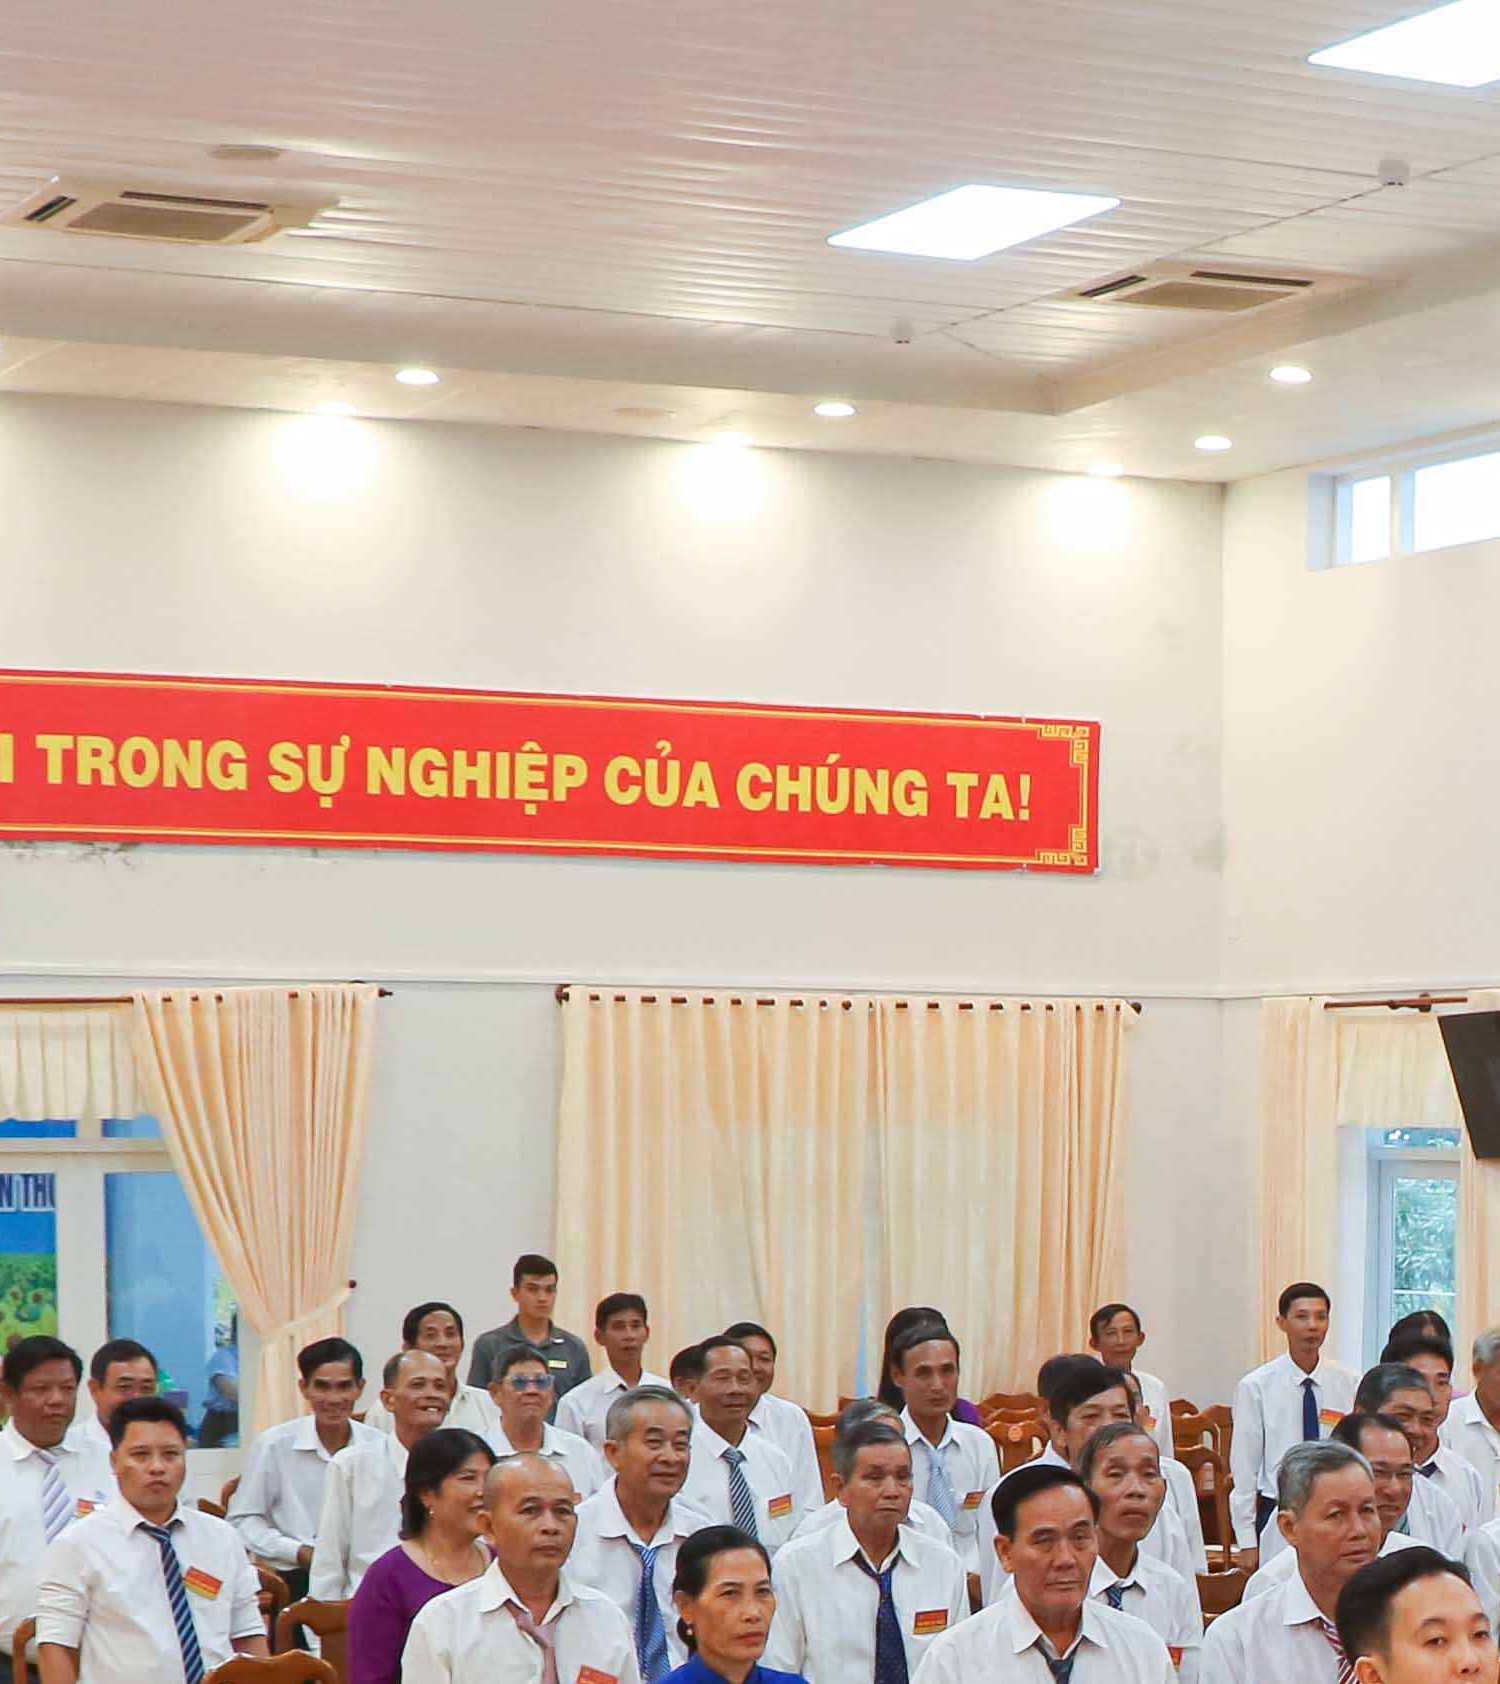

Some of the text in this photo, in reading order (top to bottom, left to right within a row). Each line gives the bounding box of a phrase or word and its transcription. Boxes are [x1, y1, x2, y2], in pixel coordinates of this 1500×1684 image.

[36, 735, 247, 791] TRONG
[268, 735, 350, 808] SỰ
[367, 741, 588, 815] NGHIỆP
[604, 740, 720, 808] CỦA
[736, 753, 928, 816] CHÚNG
[946, 772, 1030, 820] TA!
